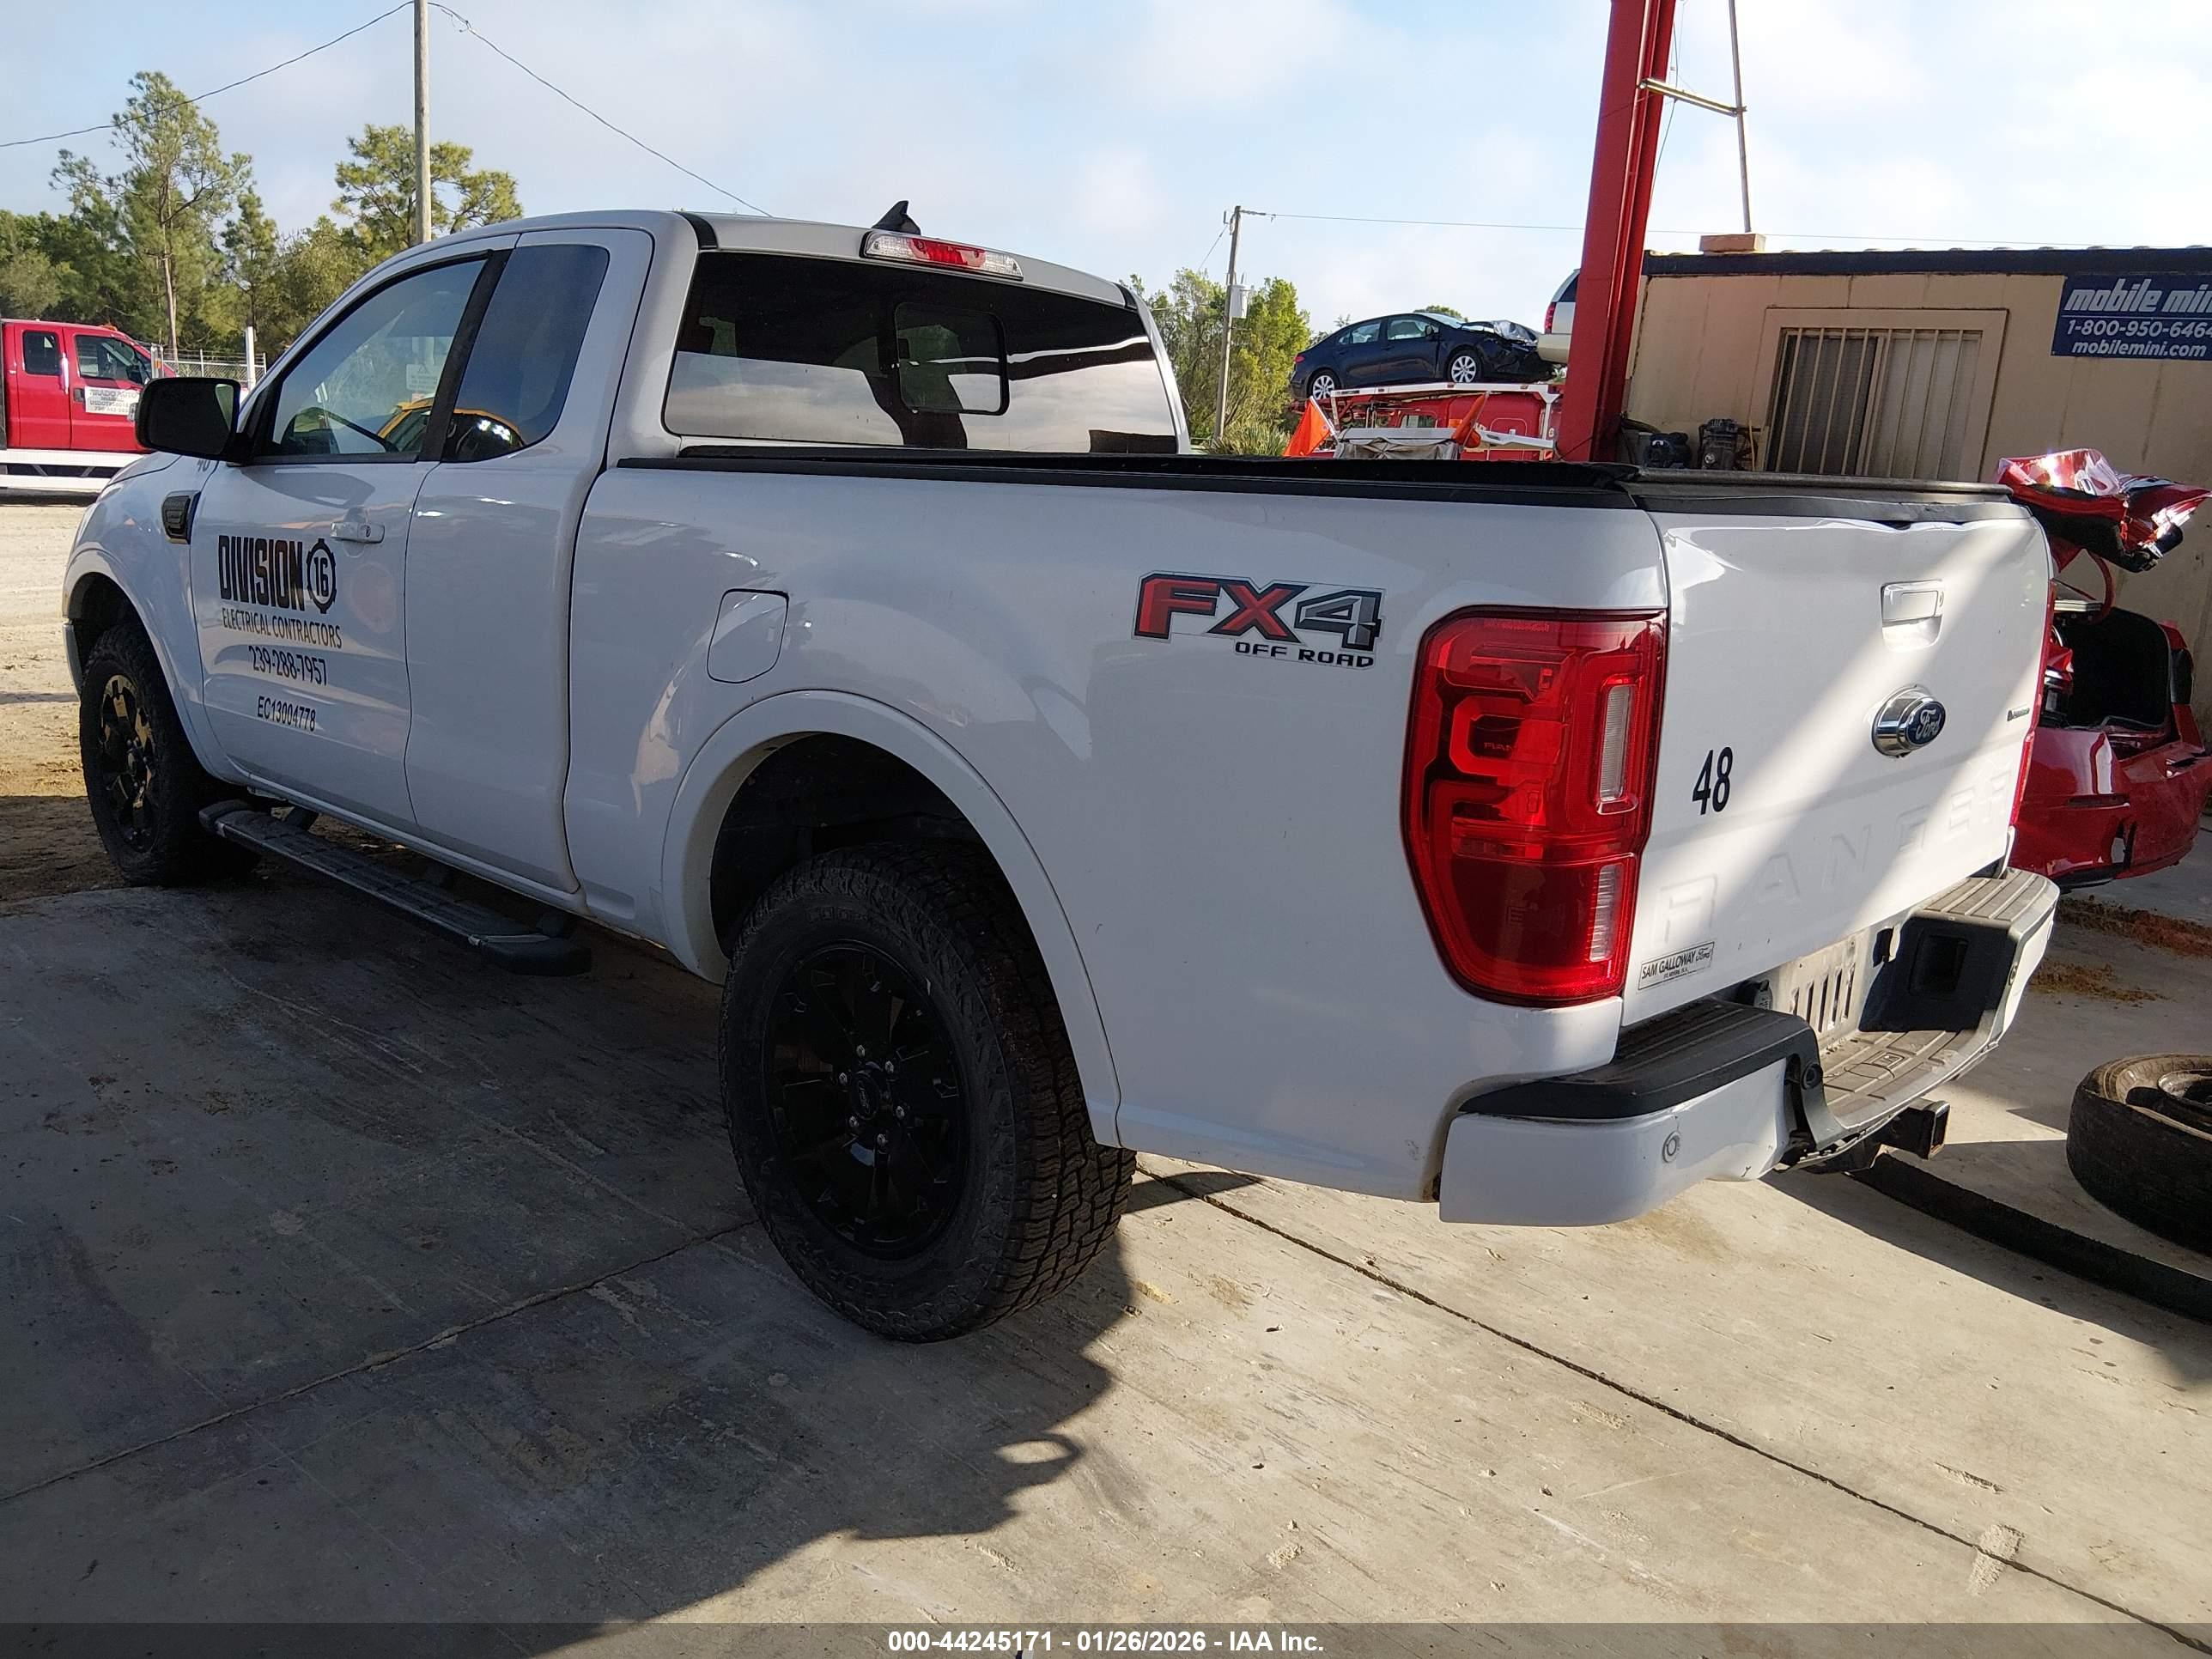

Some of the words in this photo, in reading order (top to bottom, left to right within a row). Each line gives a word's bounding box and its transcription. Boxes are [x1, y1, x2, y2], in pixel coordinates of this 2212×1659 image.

[2064, 278, 2162, 313] mobile
[2071, 339, 2208, 357] mobilemini.com
[218, 534, 306, 611] DIVISION
[313, 556, 330, 598] 16
[222, 607, 271, 636] ELECTRICAL
[272, 615, 343, 649] CONTRACTORS
[1134, 573, 1382, 652] FX4
[248, 645, 328, 686] 239-288-7957
[1235, 641, 1287, 658] OFF
[1297, 648, 1374, 668] ROAD
[257, 695, 317, 732] EC13004778
[1915, 708, 1942, 740] Ford
[1692, 746, 1734, 816] 48
[1654, 769, 2013, 945] RANGER
[1641, 963, 1658, 980] SAM
[1658, 950, 1697, 974] GALLOWAY
